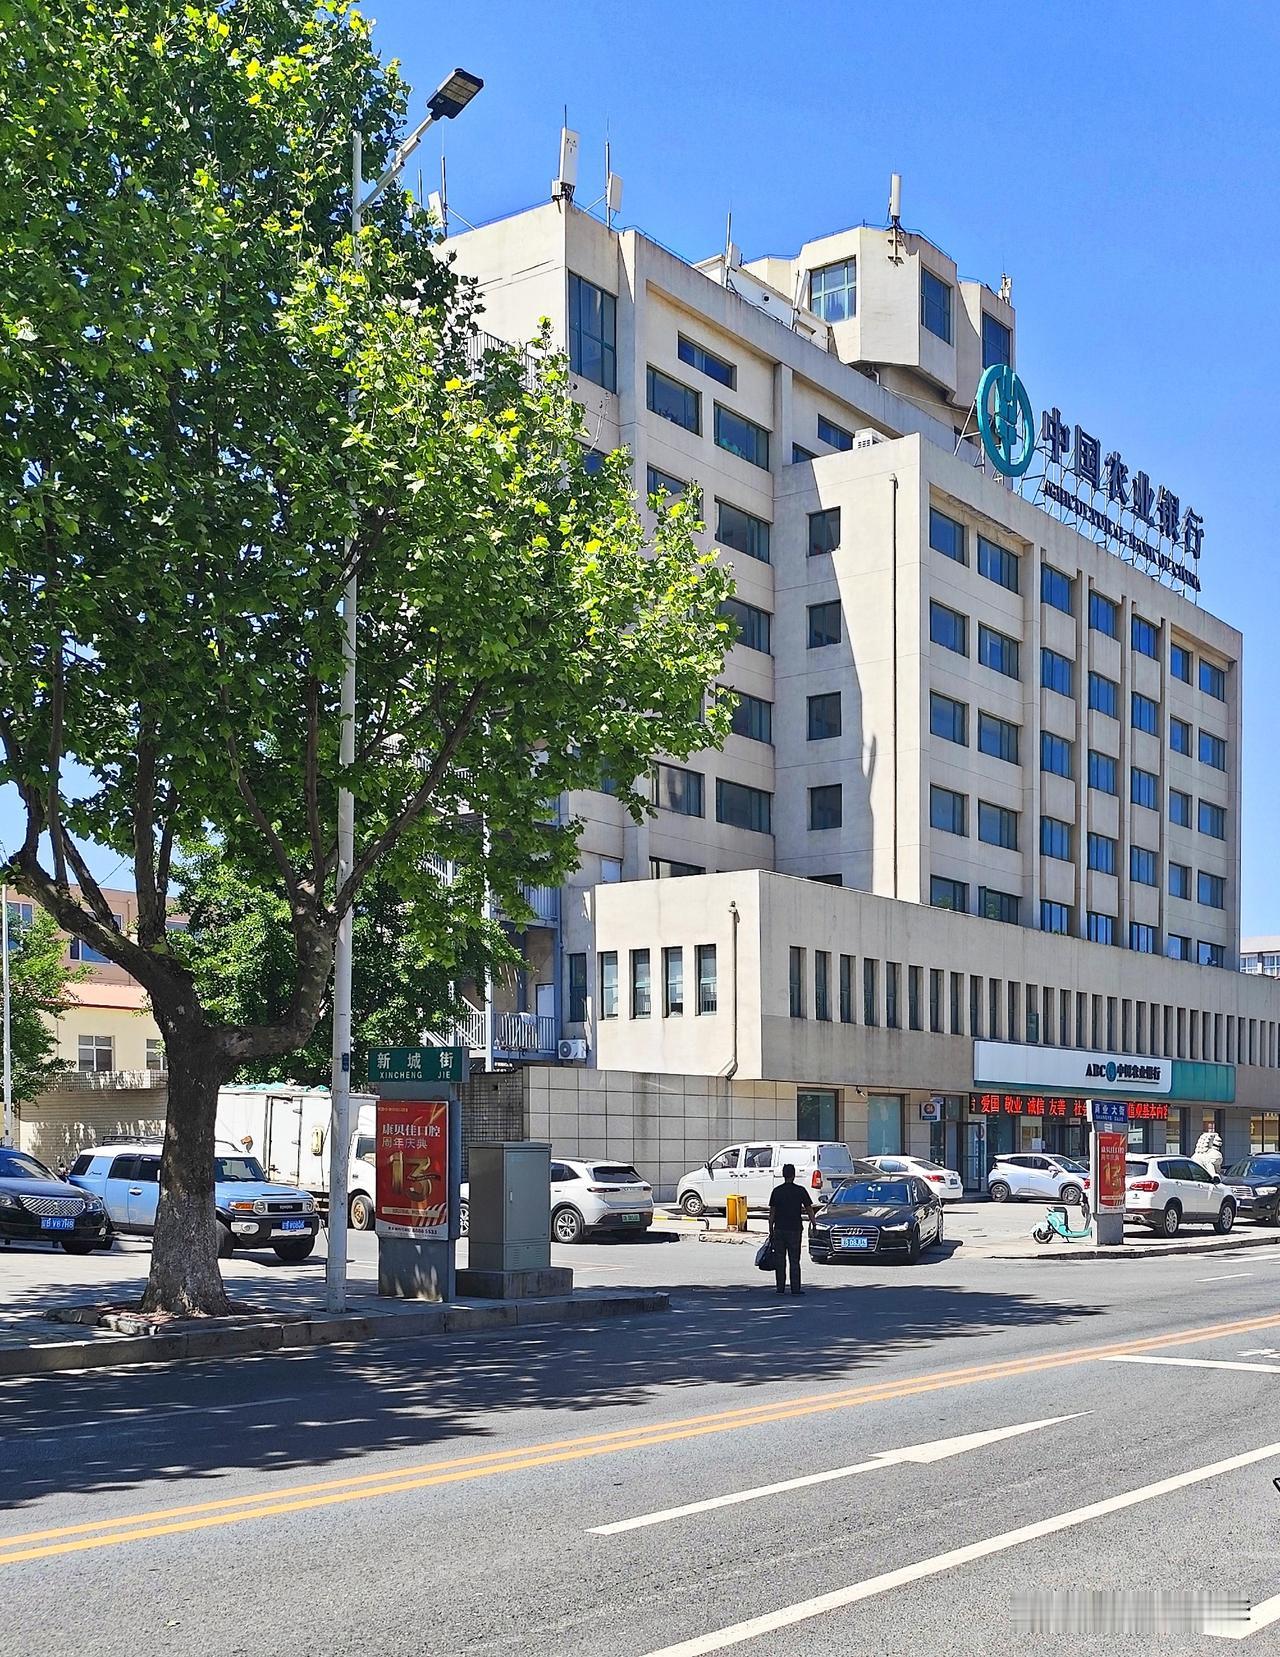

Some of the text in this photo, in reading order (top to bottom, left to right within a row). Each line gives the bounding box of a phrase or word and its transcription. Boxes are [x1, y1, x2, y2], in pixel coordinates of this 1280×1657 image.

[1042, 407, 1204, 559] 中国农业银行
[377, 1052, 454, 1069] 新城街
[380, 1071, 450, 1079] XINCHENG JIE
[1085, 1063, 1161, 1080] ABC 中国农业银行
[981, 1095, 999, 1112] 爱国
[1005, 1096, 1023, 1113] 敬业
[1027, 1097, 1045, 1115] 诚信
[1049, 1099, 1066, 1115] 友善
[1095, 1103, 1125, 1116] 商业大街
[383, 1123, 440, 1137] 康贝佳口腔
[382, 1136, 428, 1149] 周年庆典
